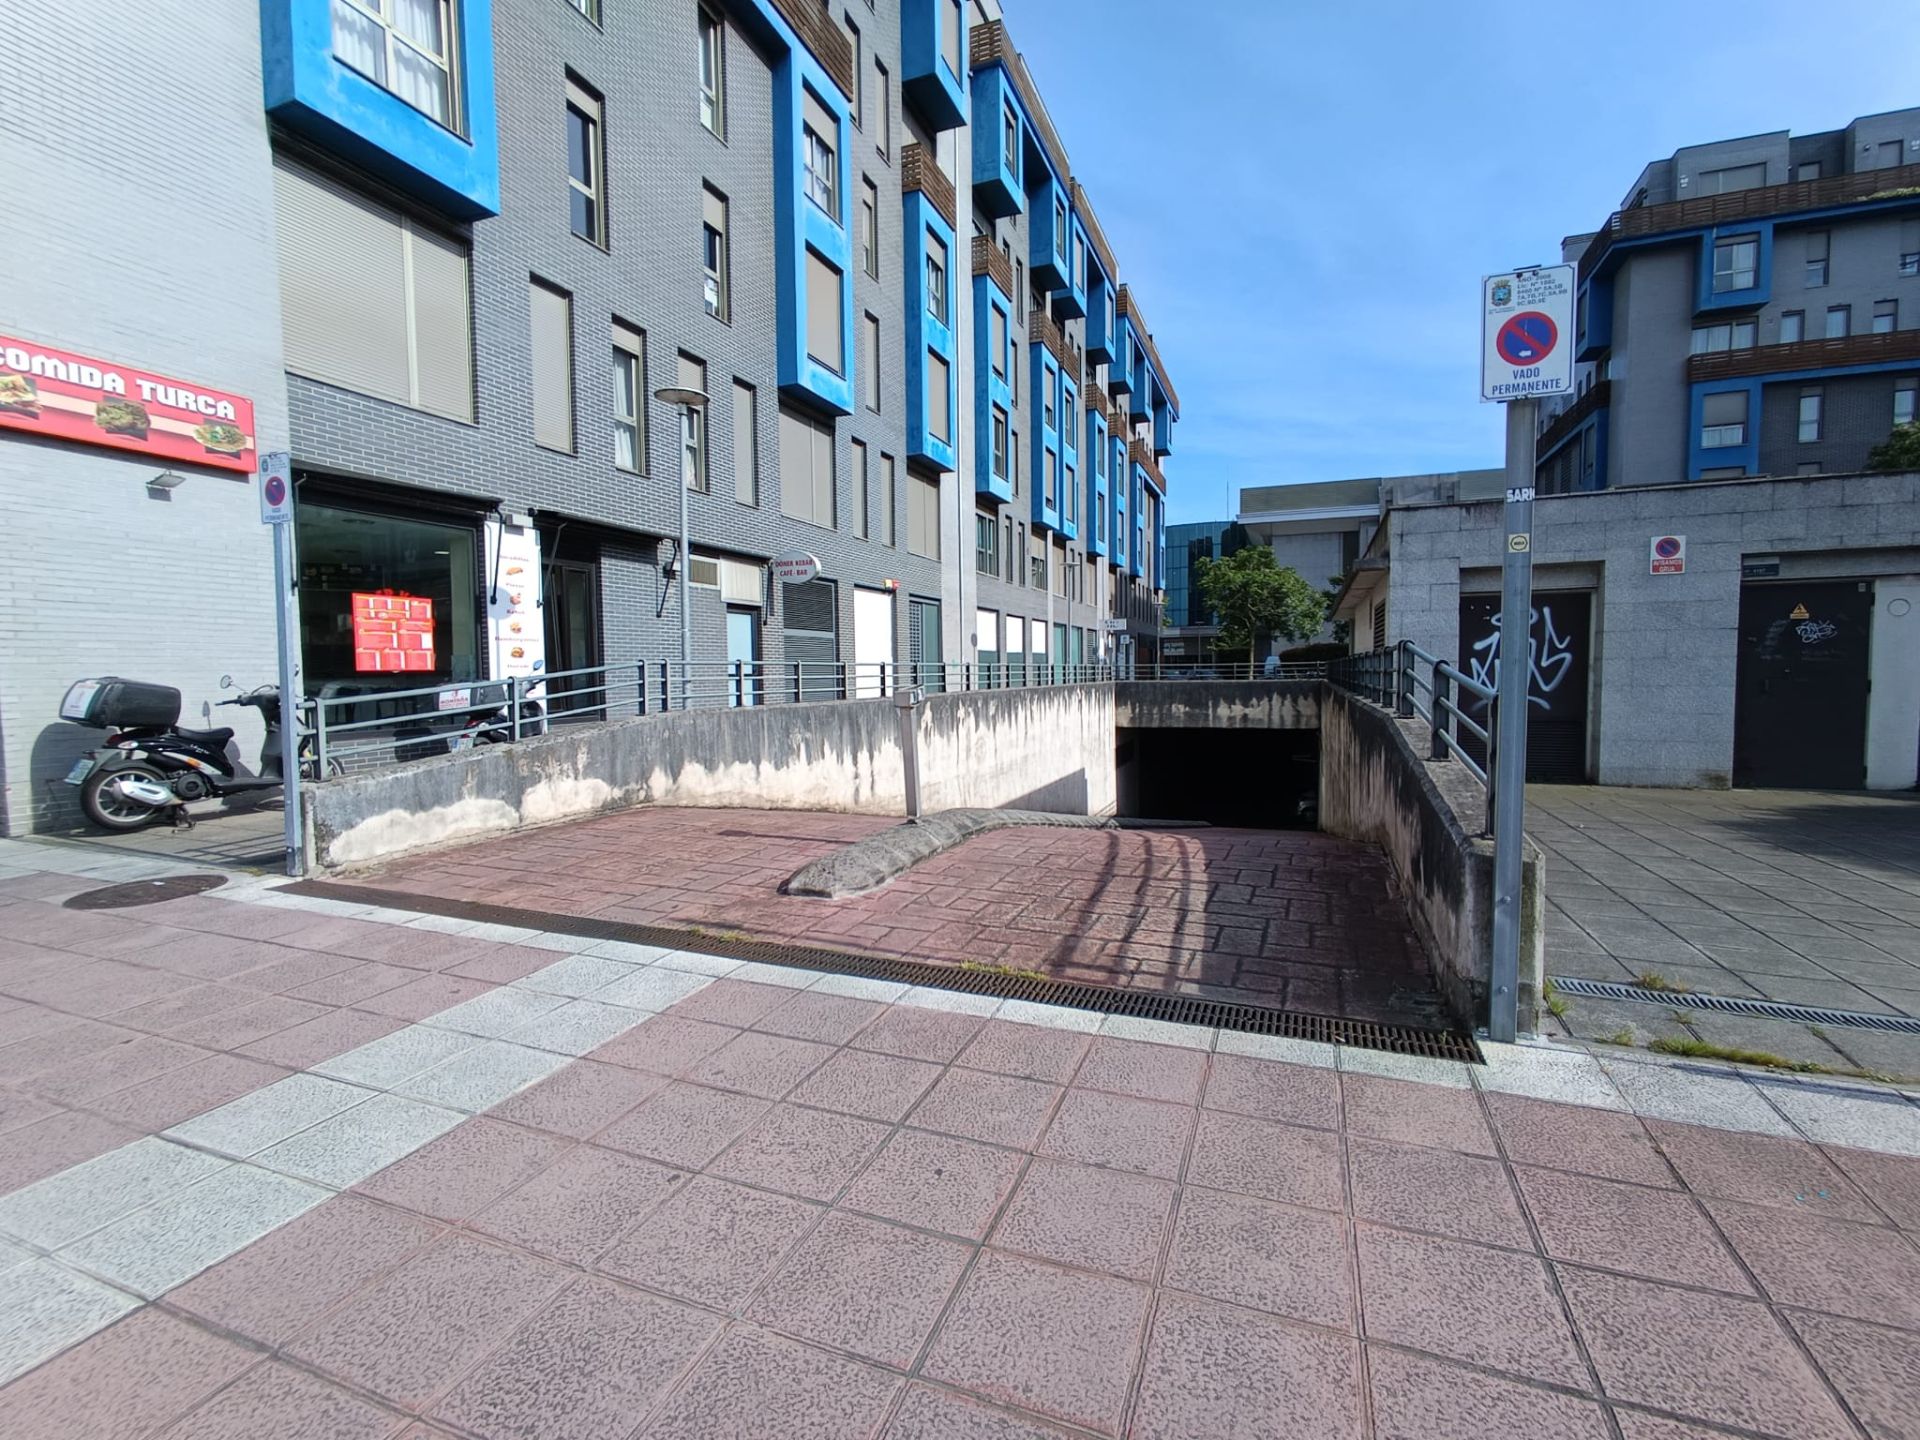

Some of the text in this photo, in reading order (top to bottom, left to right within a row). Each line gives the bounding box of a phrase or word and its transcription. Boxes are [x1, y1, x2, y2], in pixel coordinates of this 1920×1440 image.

[1512, 367, 1540, 380] VADO
[0, 346, 236, 421] OMIDA TURCA
[1491, 378, 1562, 395] PERMANENTE
